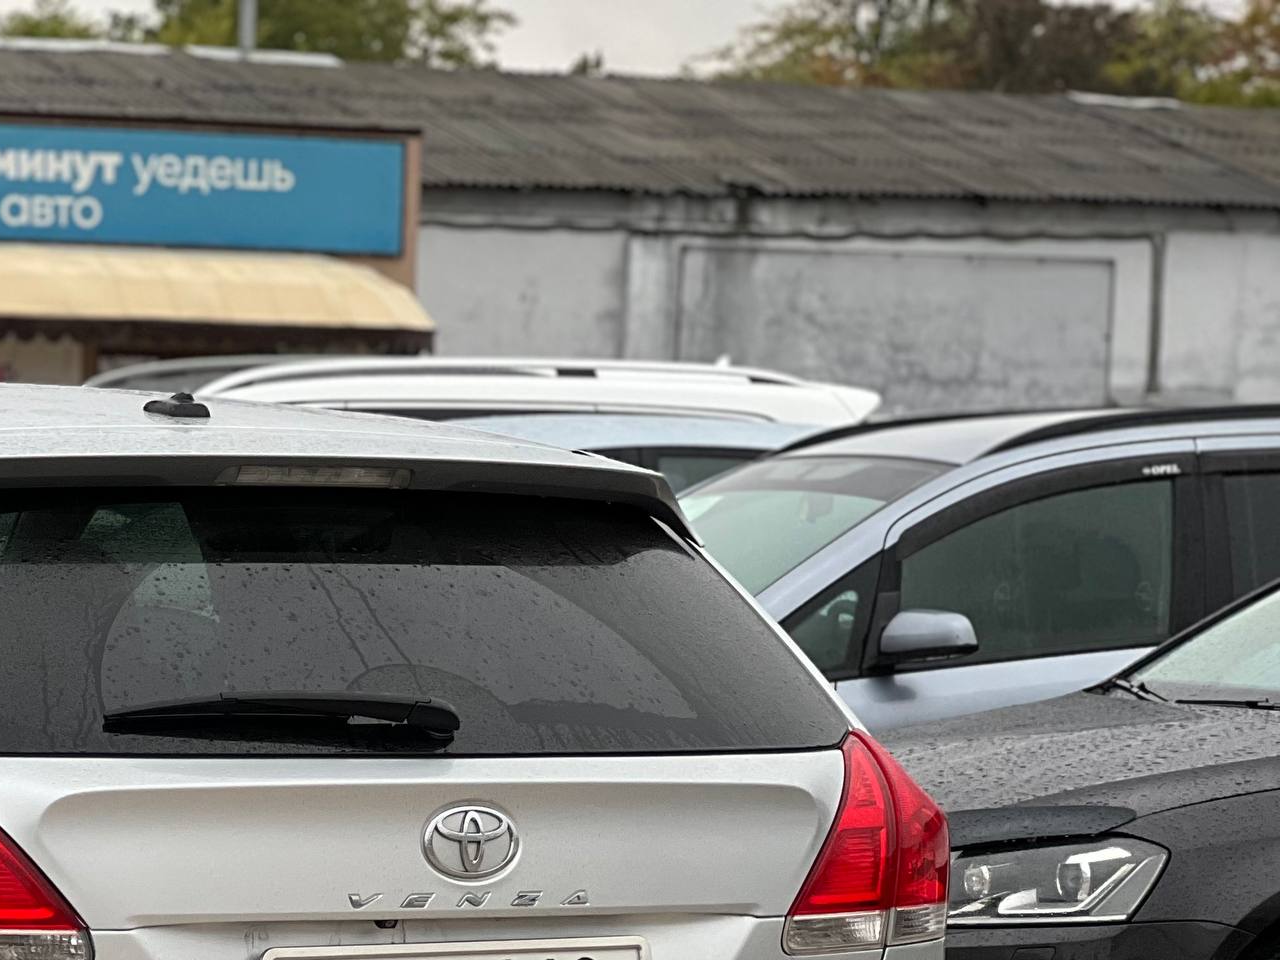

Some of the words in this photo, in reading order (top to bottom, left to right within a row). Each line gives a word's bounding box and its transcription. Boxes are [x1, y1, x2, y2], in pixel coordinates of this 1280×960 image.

[131, 153, 296, 195] уедешь
[0, 193, 103, 229] авто
[1151, 464, 1182, 476] OPEL
[347, 889, 590, 909] VENZA
